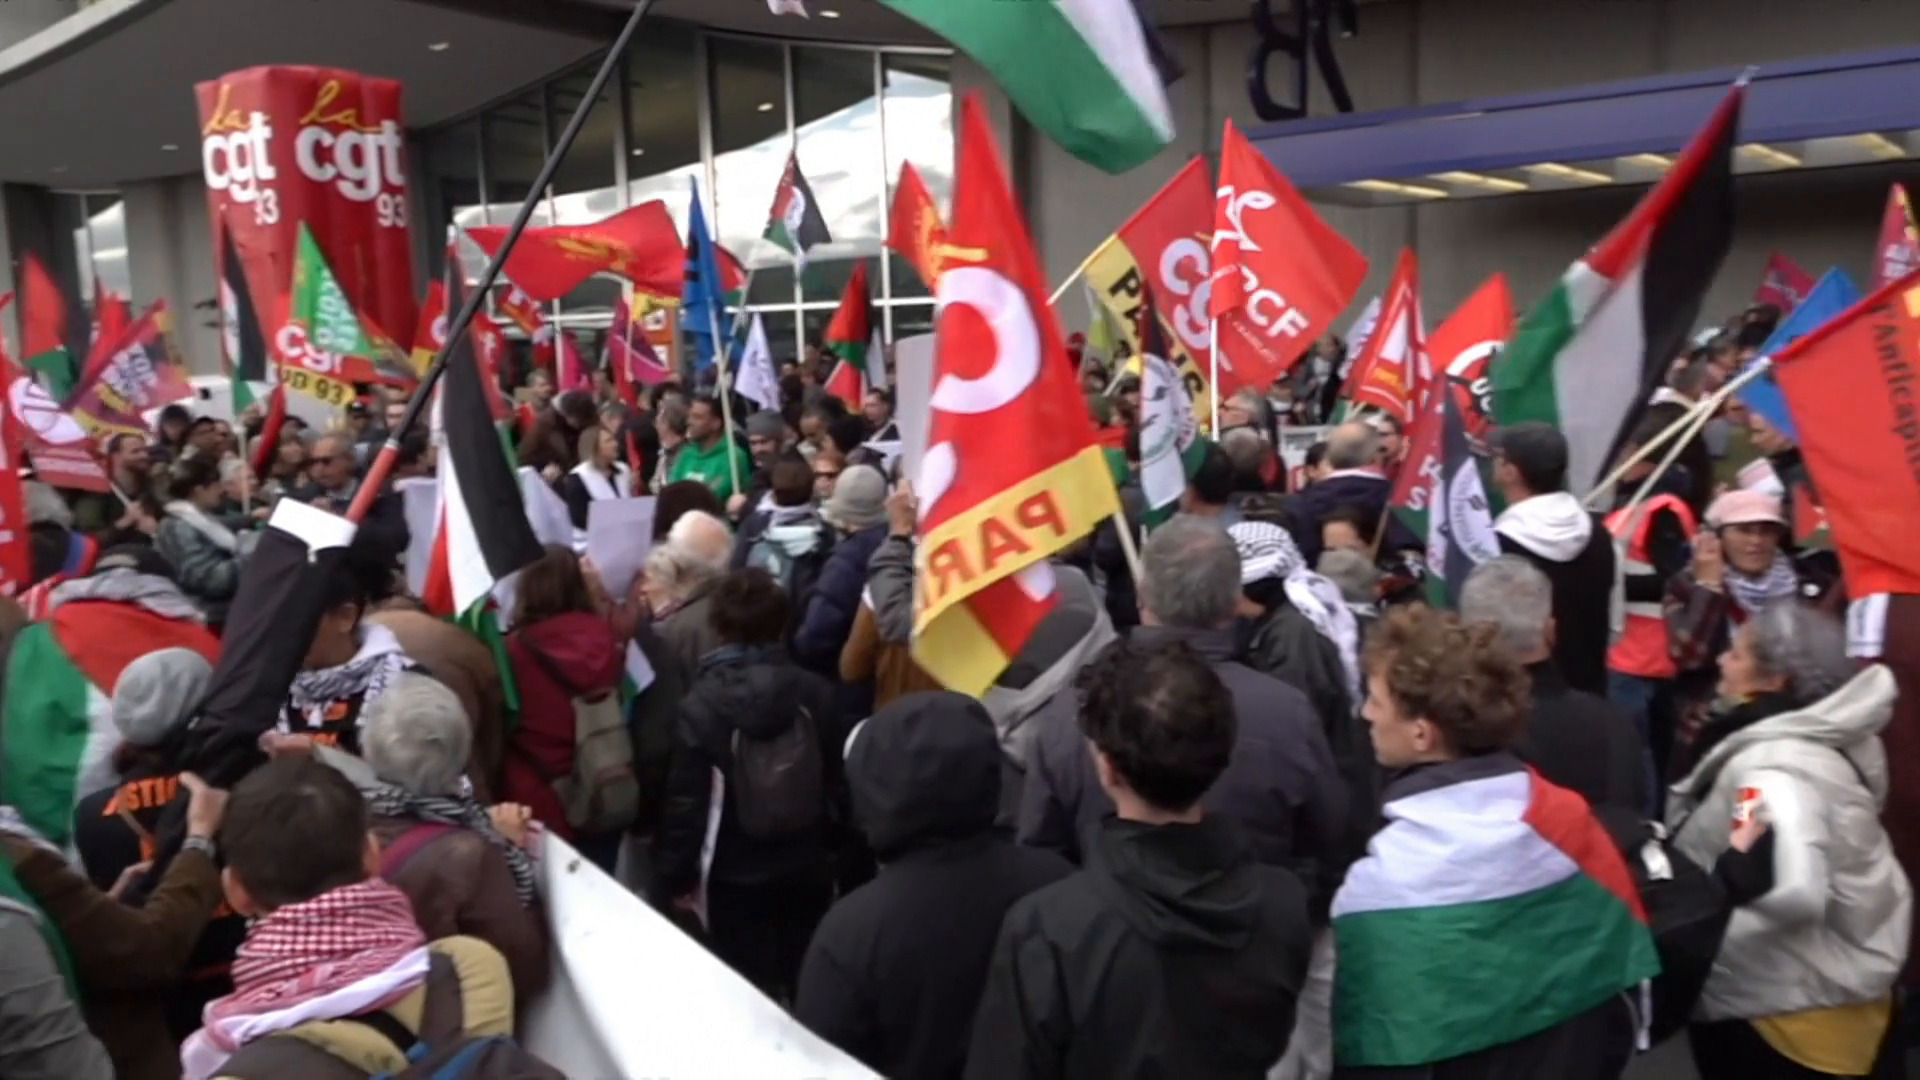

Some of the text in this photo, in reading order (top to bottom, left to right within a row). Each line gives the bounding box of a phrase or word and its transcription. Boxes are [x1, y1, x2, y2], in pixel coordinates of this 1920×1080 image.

[203, 111, 276, 203] cgt
[295, 120, 405, 201] cgt
[376, 193, 408, 228] 93
